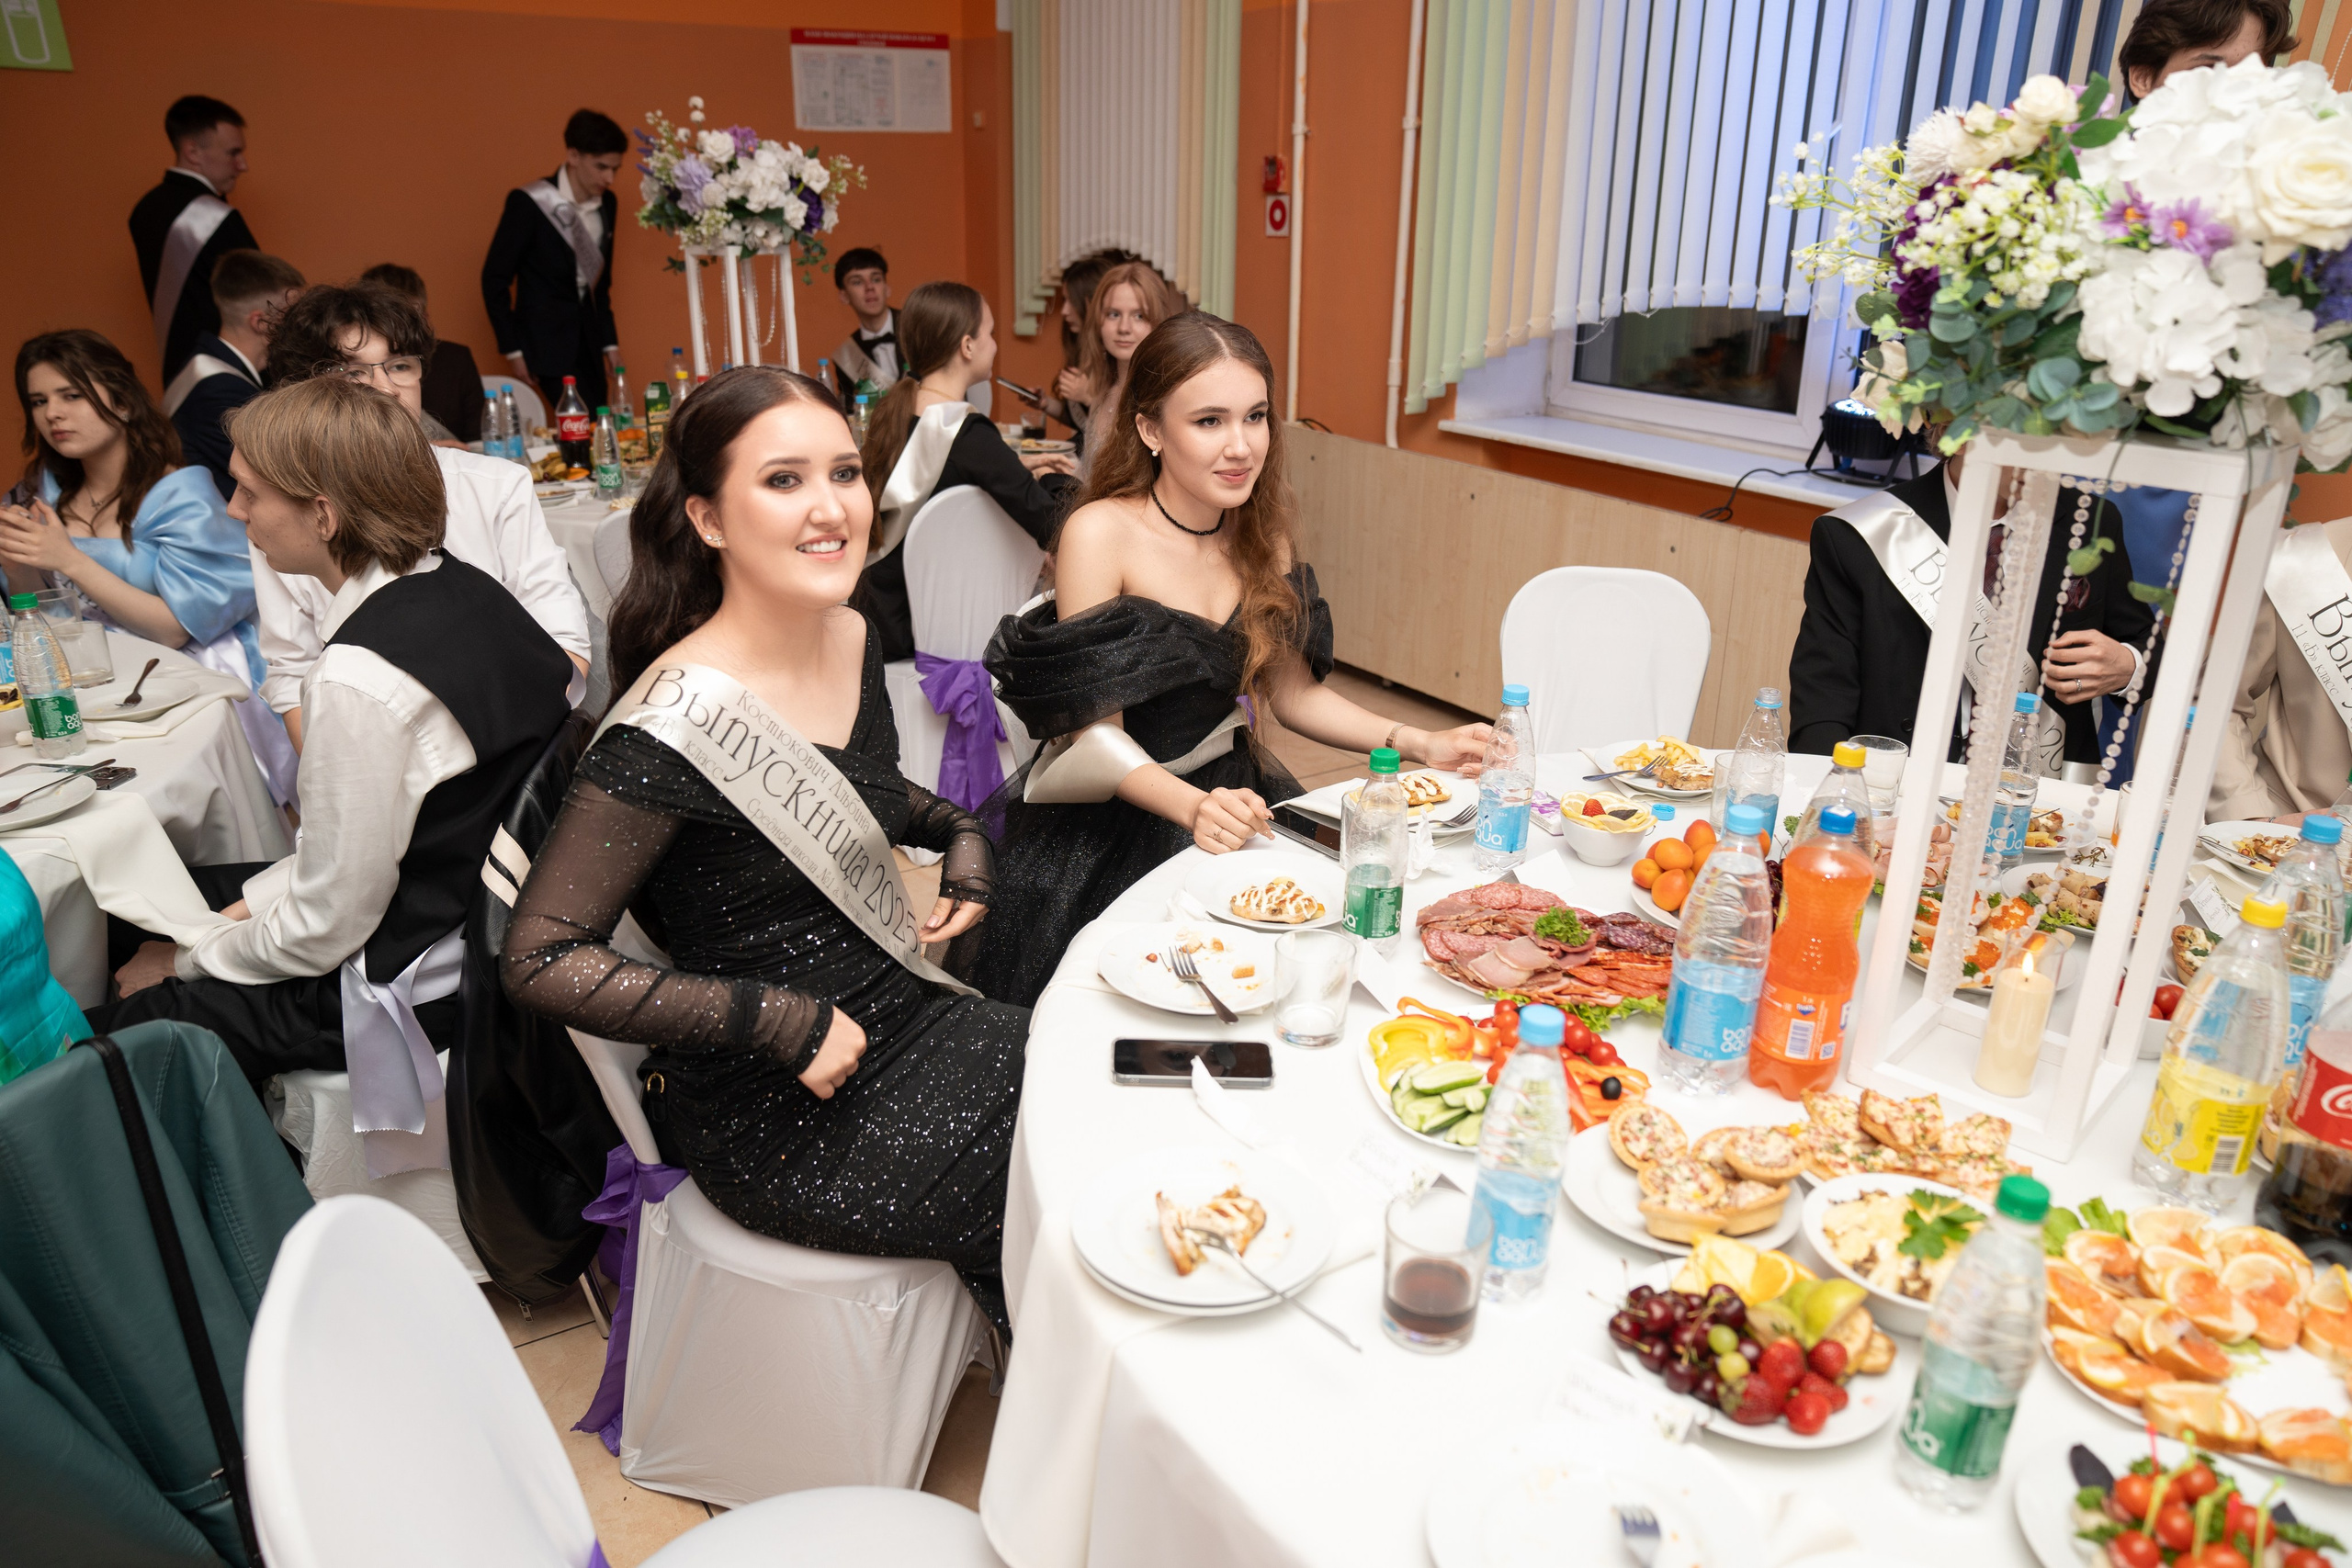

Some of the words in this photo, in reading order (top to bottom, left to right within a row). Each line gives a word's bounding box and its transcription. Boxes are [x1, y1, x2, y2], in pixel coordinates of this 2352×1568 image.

[2290, 624, 2308, 638] 11
[2302, 642, 2320, 662] «Б»
[2314, 663, 2340, 697] класс
[683, 740, 725, 780] класс
[736, 690, 831, 784] Костюкович
[829, 777, 871, 835] Альбина
[636, 668, 870, 894] Выпускница
[864, 861, 919, 953] 2025
[746, 797, 793, 848] Средняя
[790, 844, 819, 874] школа
[1476, 828, 1503, 846] qua
